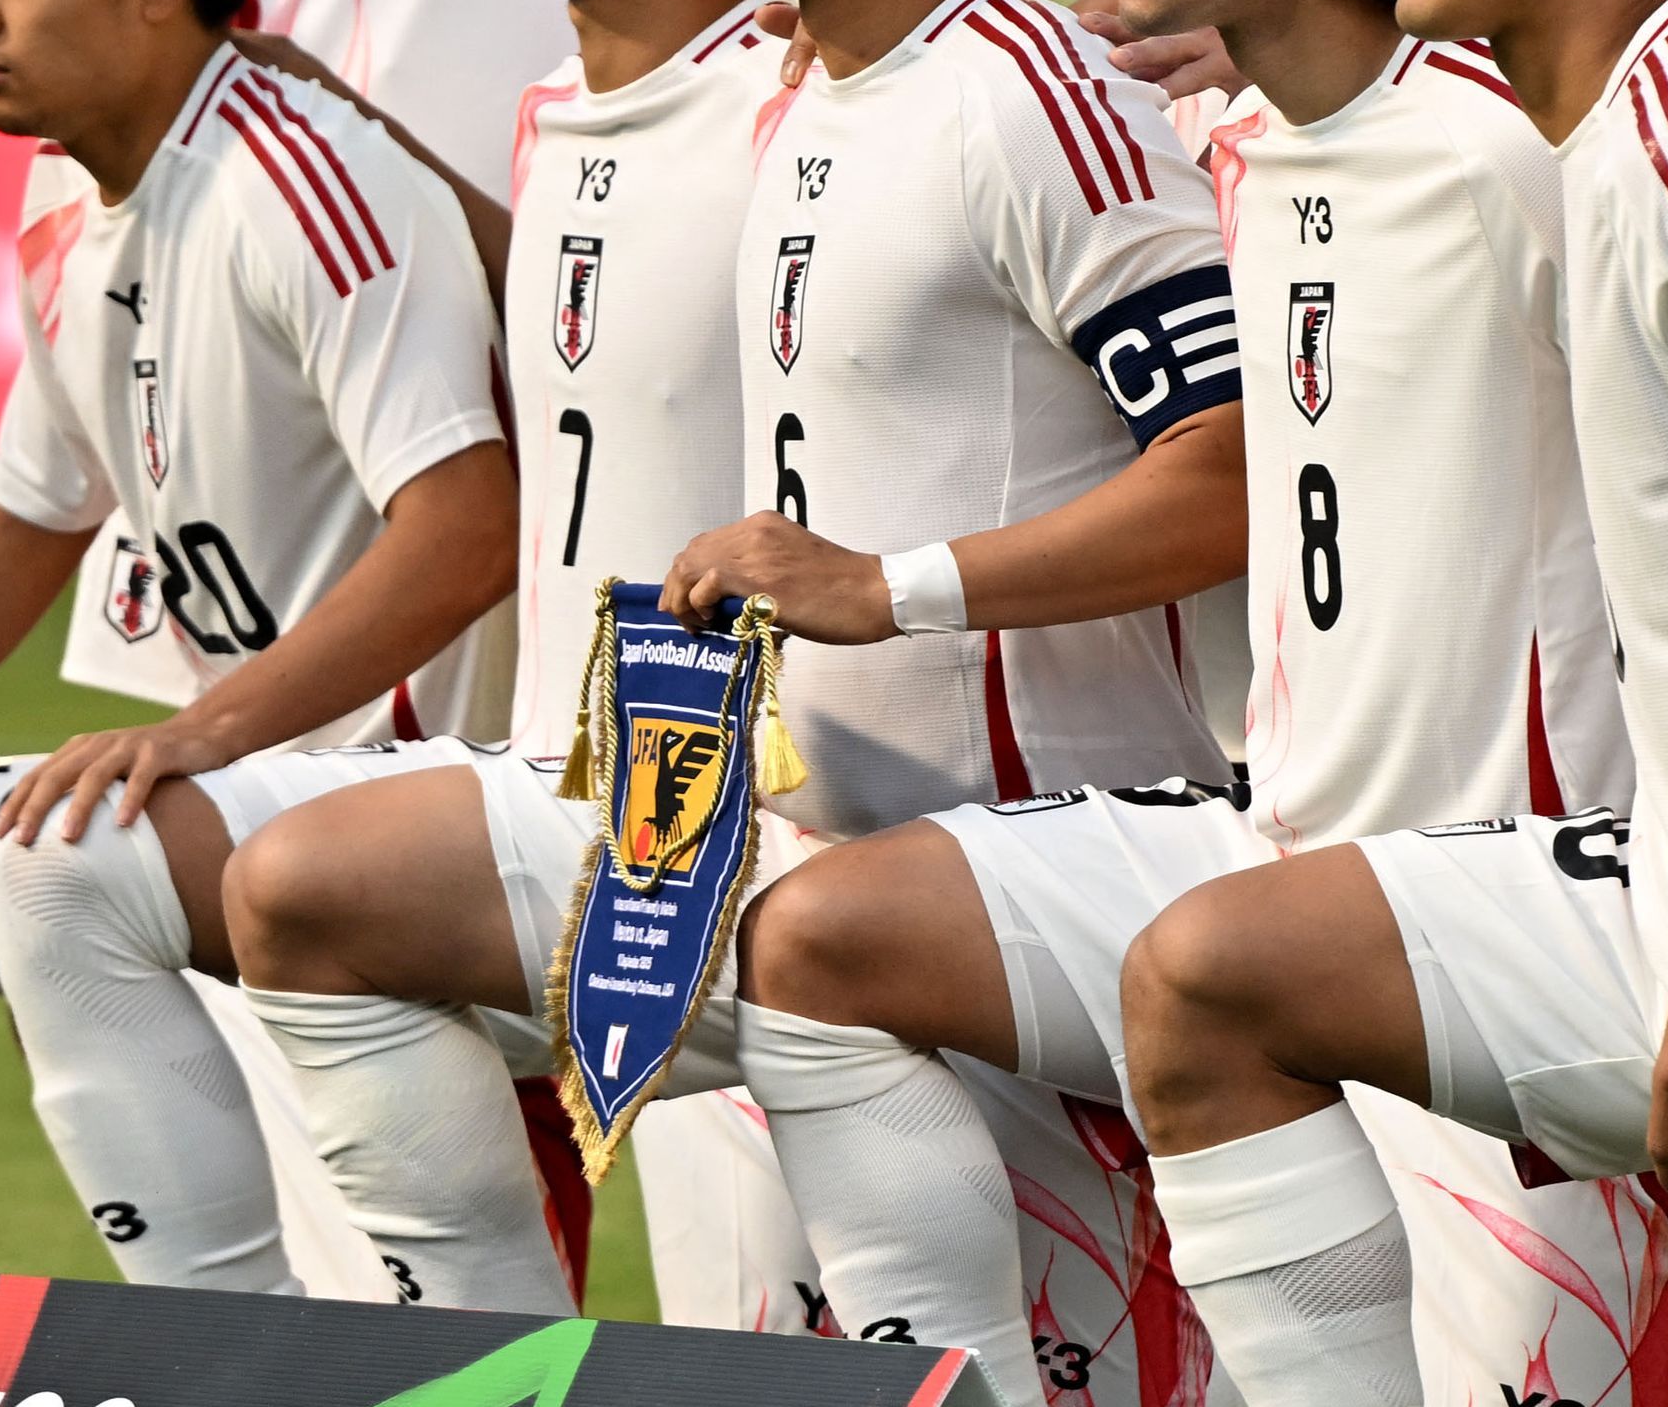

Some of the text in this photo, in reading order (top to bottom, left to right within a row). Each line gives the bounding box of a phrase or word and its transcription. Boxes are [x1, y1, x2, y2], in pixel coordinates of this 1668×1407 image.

[576, 156, 616, 202] Y-3
[797, 157, 833, 202] Y-3
[1292, 196, 1333, 244] Y-3
[1299, 286, 1325, 297] JAPAN
[559, 408, 594, 567] 7
[775, 412, 808, 530] 6
[1298, 463, 1343, 632] 8
[641, 639, 699, 668] Football
[633, 728, 658, 766] JFA
